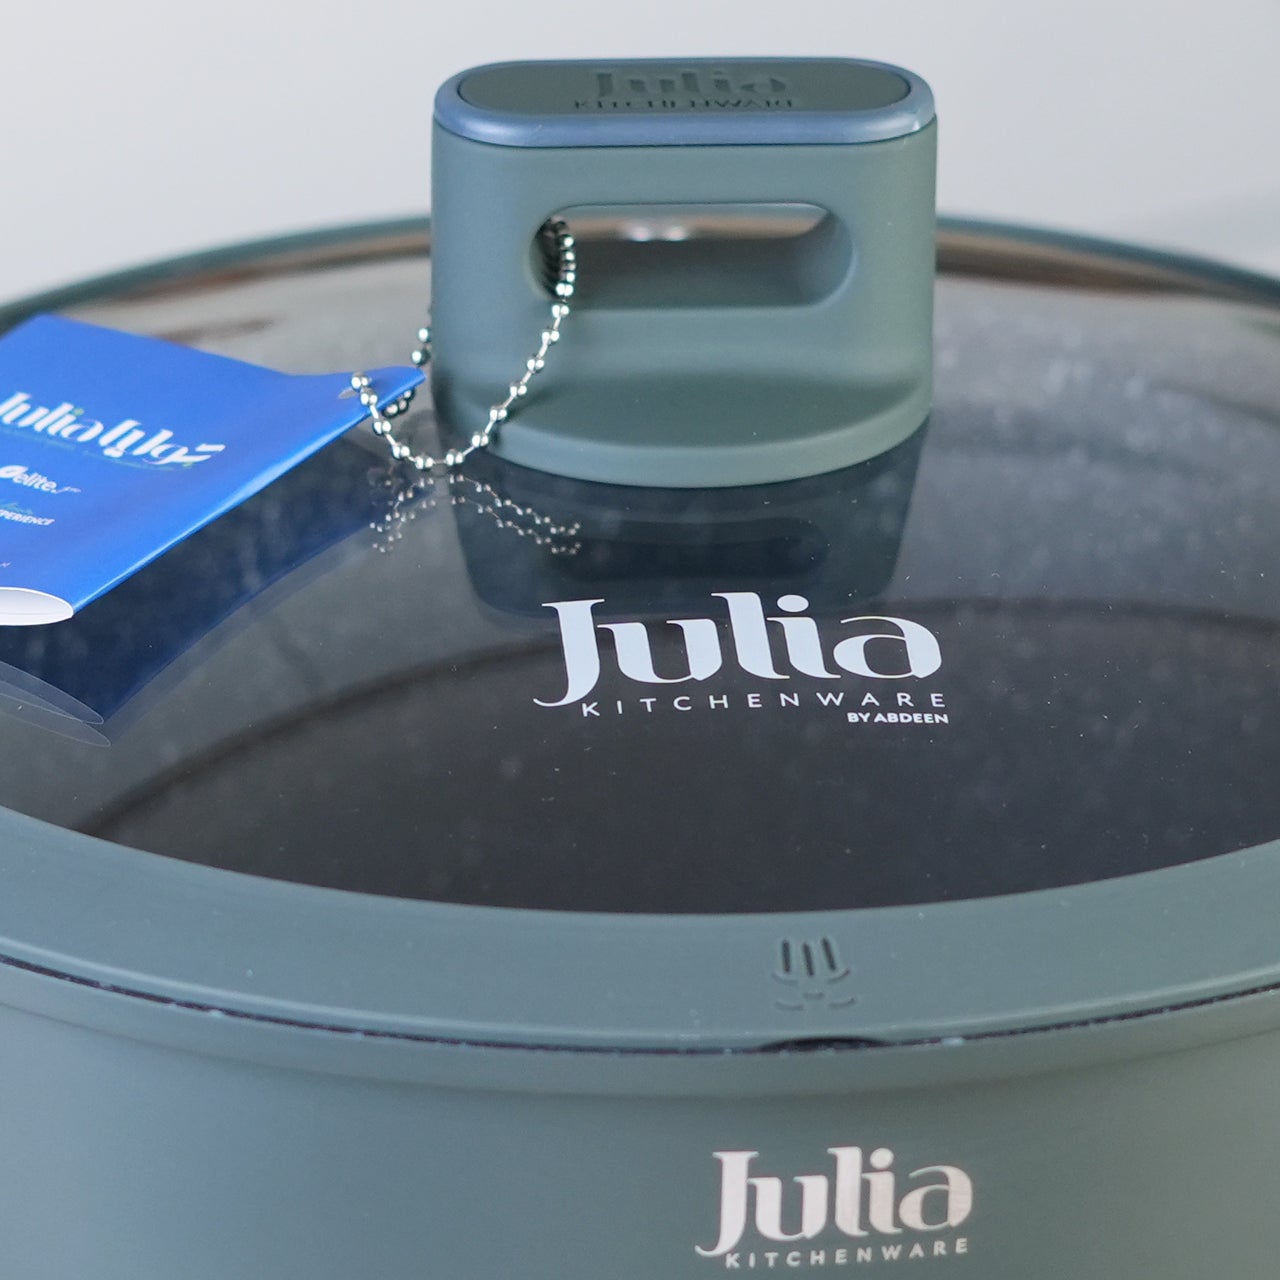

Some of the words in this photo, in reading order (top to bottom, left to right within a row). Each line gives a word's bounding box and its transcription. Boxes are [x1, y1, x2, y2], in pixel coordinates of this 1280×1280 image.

[533, 591, 942, 707] Julia
[581, 691, 946, 718] KITCHENWARE
[846, 711, 870, 723] BY
[873, 712, 949, 724] ABDEEN
[694, 1145, 972, 1257] Julia
[725, 1237, 969, 1269] KITCHENWARE
